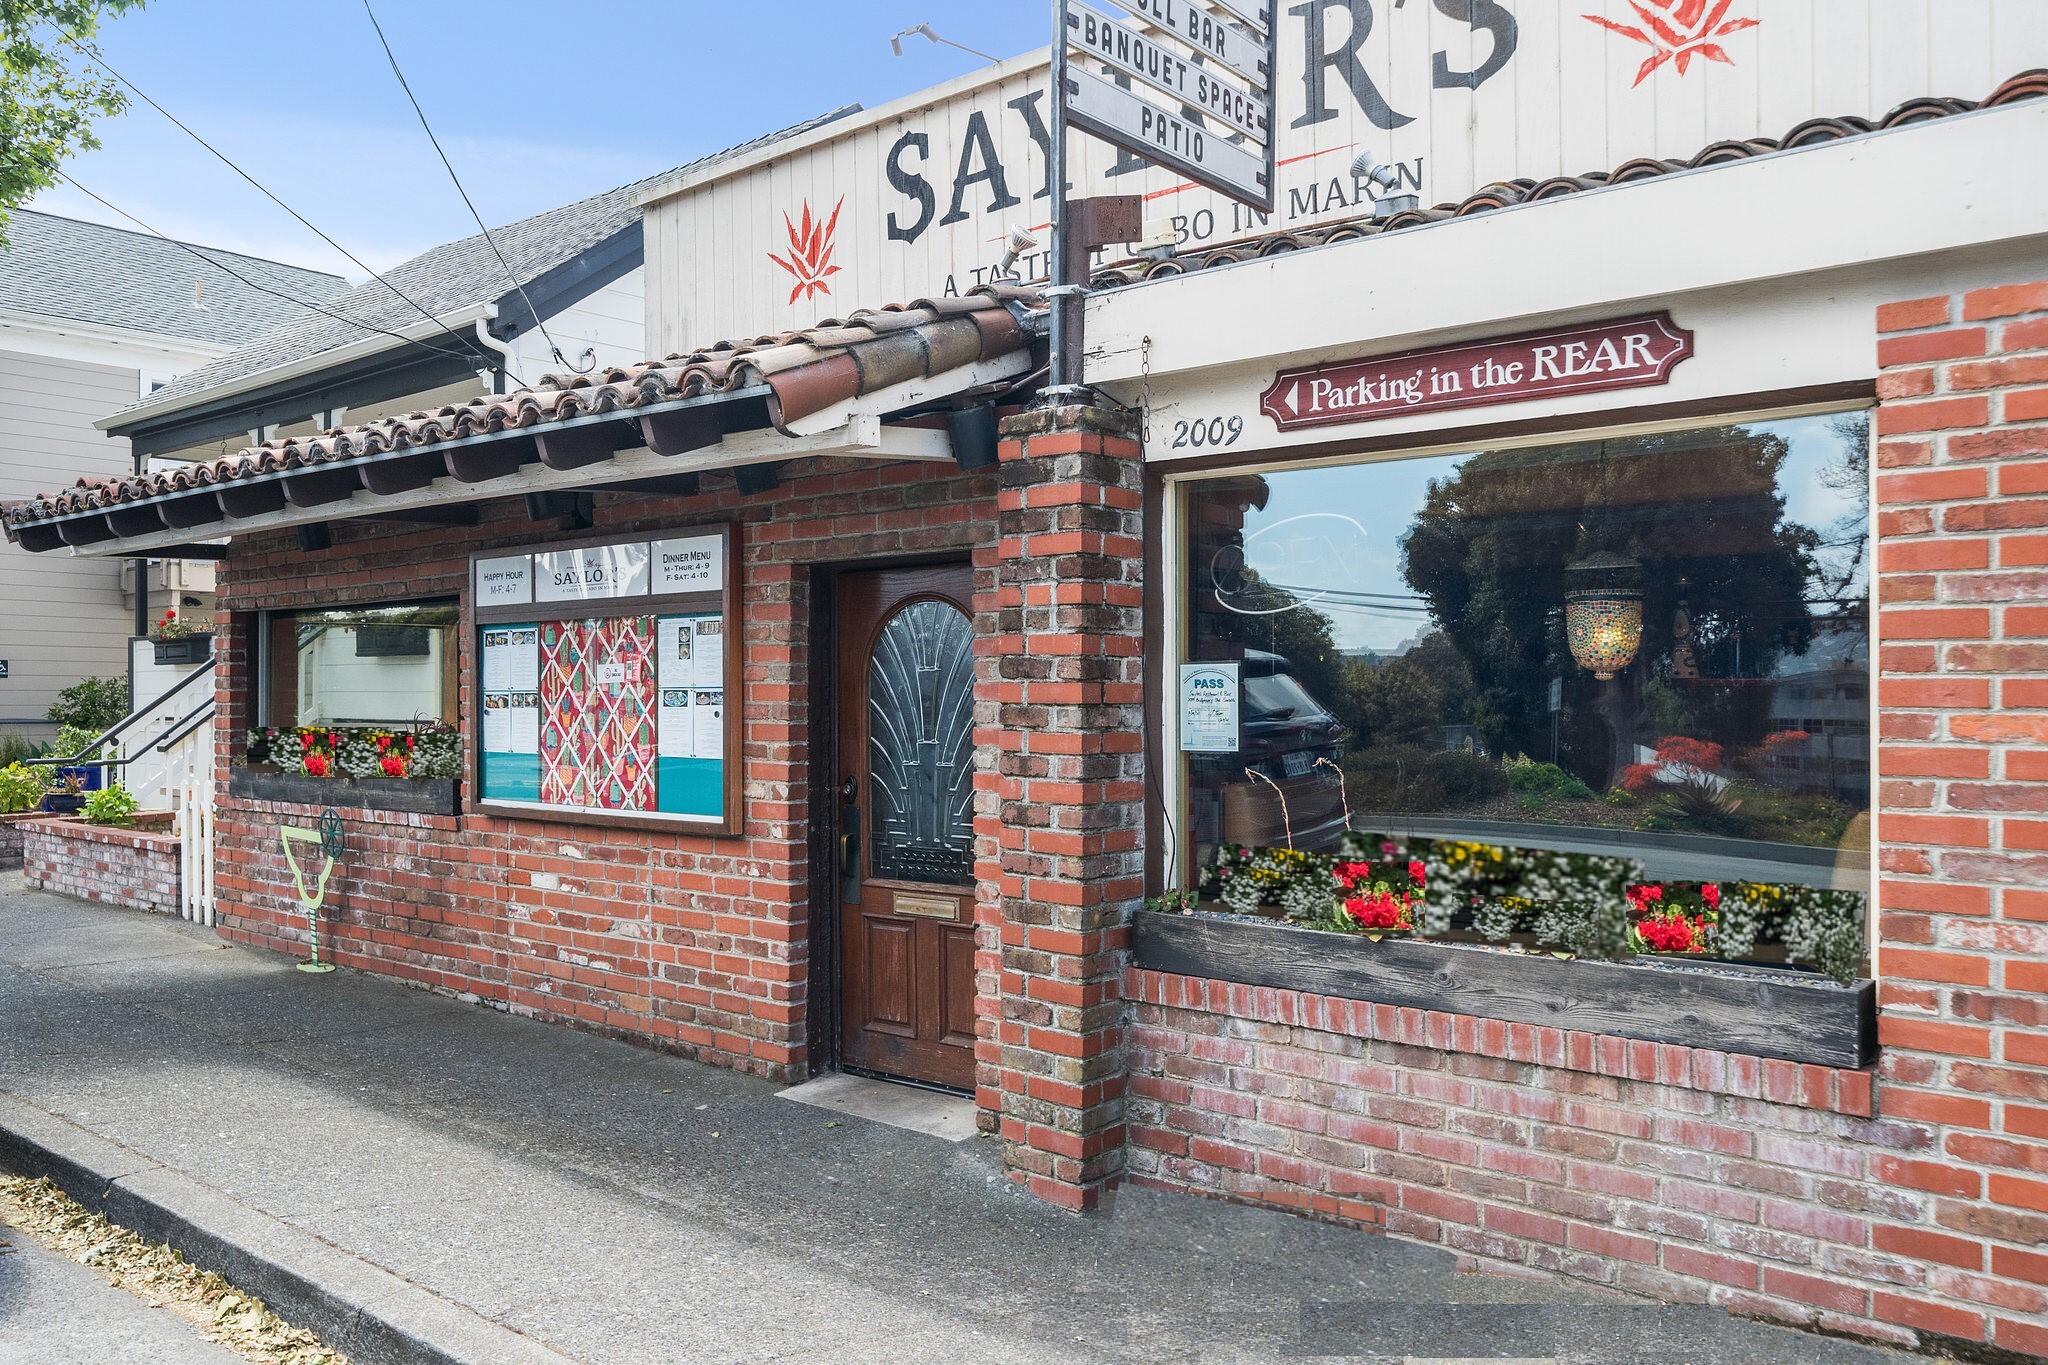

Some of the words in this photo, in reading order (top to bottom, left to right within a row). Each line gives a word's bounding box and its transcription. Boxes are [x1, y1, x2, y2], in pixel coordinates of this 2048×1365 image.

[1188, 7, 1226, 58] BAR
[1085, 12, 1187, 92] BANQUET
[1197, 75, 1255, 130] SPACE
[886, 0, 1519, 245] SAYRS
[1141, 105, 1205, 163] PATIO
[943, 274, 961, 298] A
[1288, 156, 1425, 220] MARN
[1308, 369, 1424, 413] Parking
[1428, 366, 1464, 396] in
[1469, 357, 1524, 390] the
[1530, 333, 1661, 383] REAR
[1171, 414, 1244, 450] 2009
[483, 572, 504, 581] HAPPY
[505, 570, 524, 580] HOUR
[1194, 678, 1225, 689] PASS
